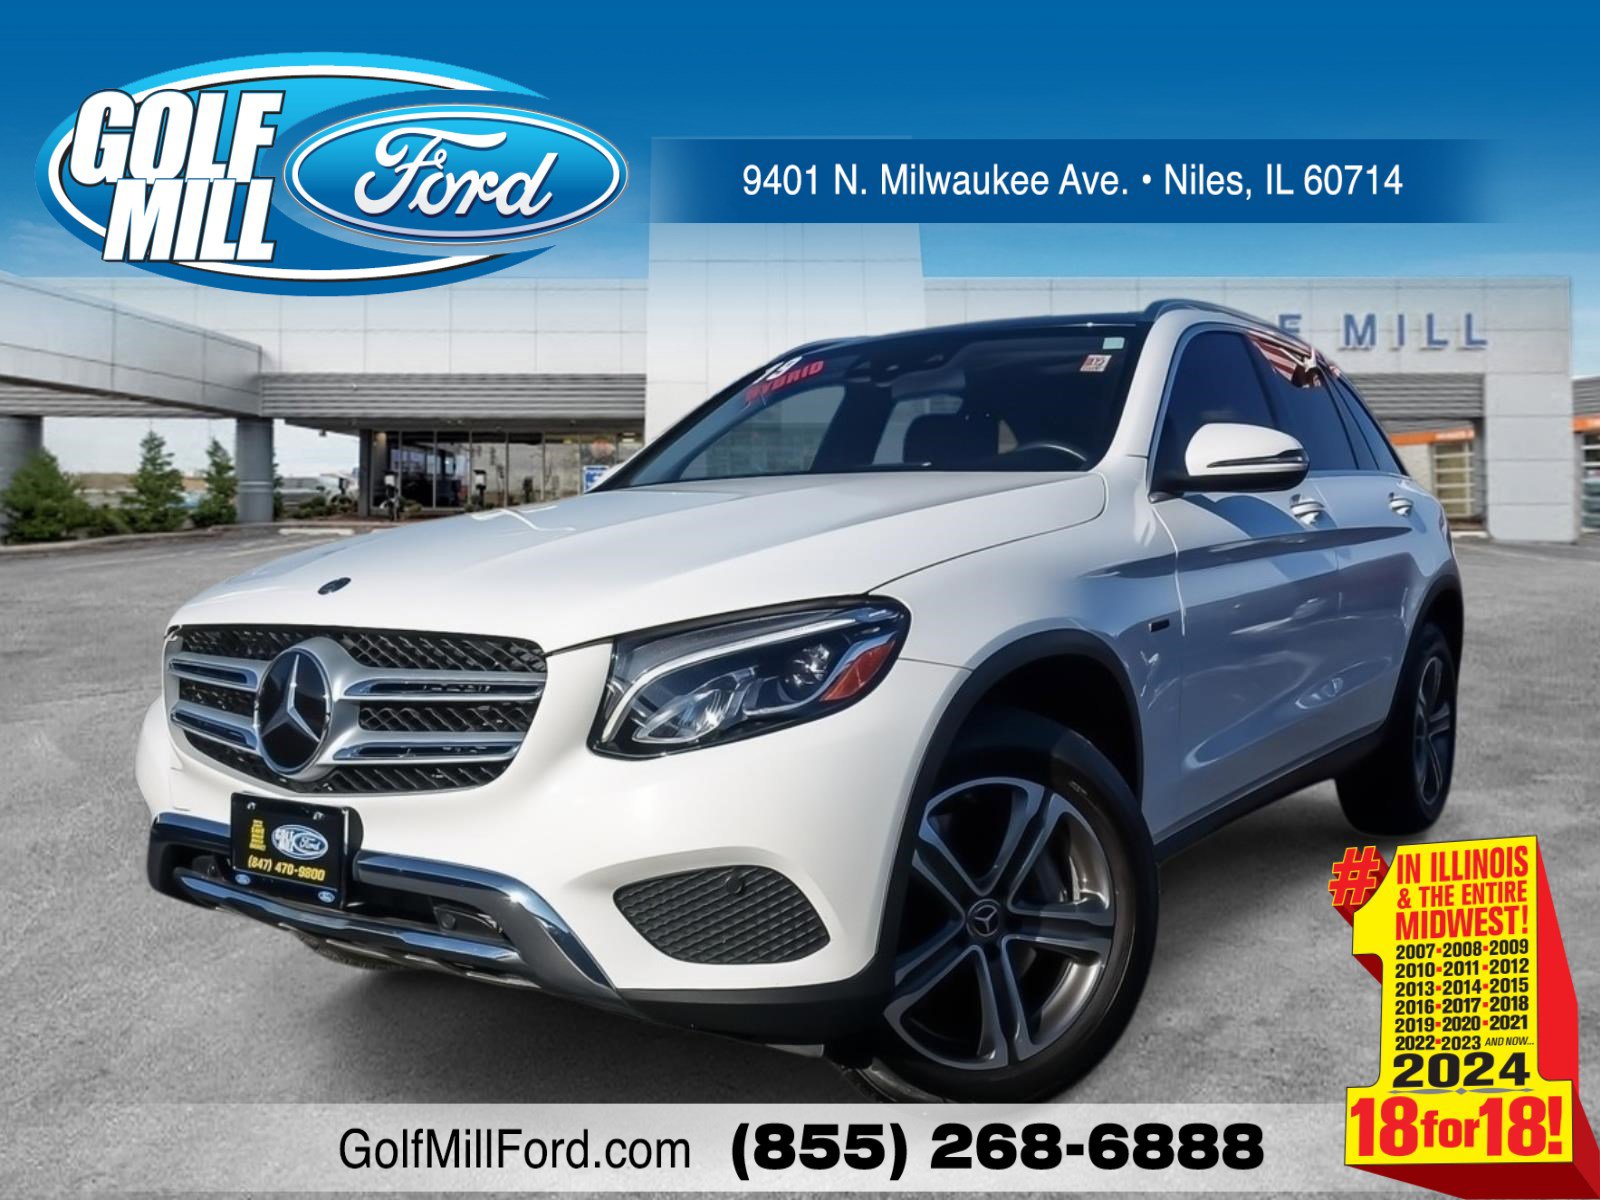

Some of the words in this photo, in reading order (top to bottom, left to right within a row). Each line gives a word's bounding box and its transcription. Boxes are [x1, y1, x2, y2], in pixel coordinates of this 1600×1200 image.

[1343, 313, 1488, 347] MILL
[248, 855, 272, 872] (847)
[275, 862, 326, 882] 470-9800
